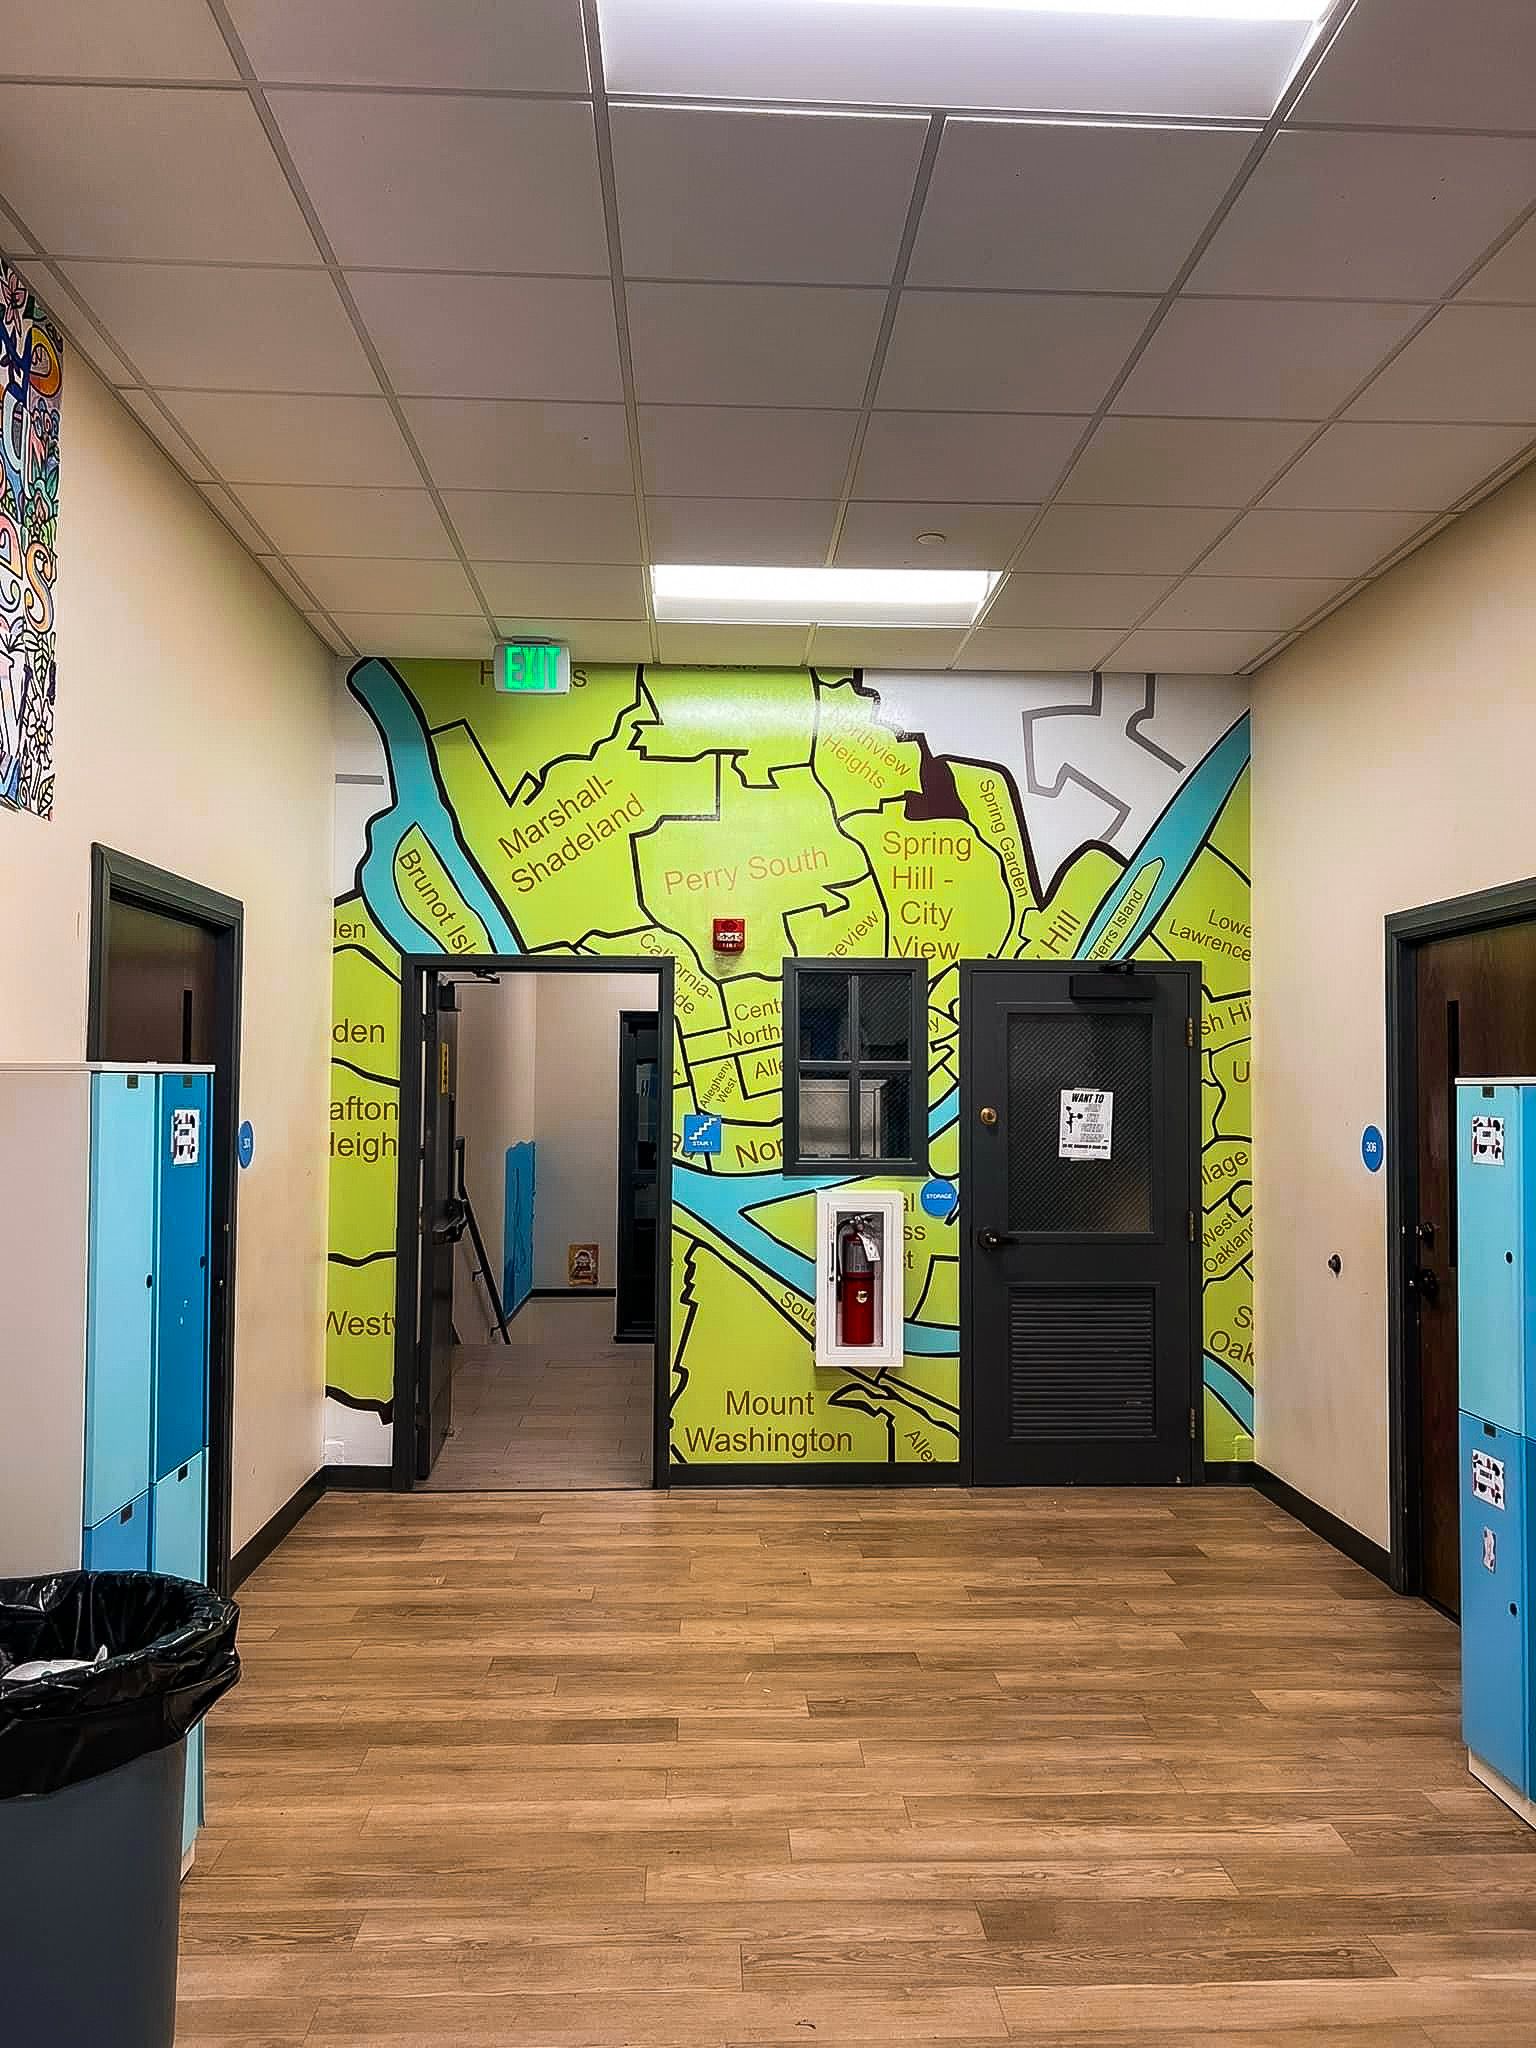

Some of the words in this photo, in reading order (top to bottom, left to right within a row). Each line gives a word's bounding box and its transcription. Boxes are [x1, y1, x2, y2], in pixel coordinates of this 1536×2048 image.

[505, 647, 561, 690] EXIT
[823, 735, 886, 789] Heights
[498, 775, 614, 859] Marshall-
[511, 793, 645, 893] Shadeland
[882, 831, 972, 861] Spring
[980, 779, 1005, 833] Spring
[1000, 837, 1029, 898] Garden
[664, 863, 738, 894] Perry
[748, 846, 828, 880] South
[893, 866, 933, 890] Hill
[398, 849, 455, 927] Brunot
[900, 901, 953, 930] City
[1112, 889, 1144, 928] Island
[893, 935, 960, 958] View
[1040, 910, 1080, 954] Hill
[1169, 919, 1251, 961] Lawrence
[332, 1018, 385, 1042] den
[699, 1060, 733, 1108] Allegheny
[716, 1077, 738, 1103] West
[1071, 1093, 1093, 1103] WANT
[1094, 1094, 1104, 1103] TO
[330, 1096, 399, 1121] afton
[1366, 1142, 1377, 1152] 306
[1202, 1212, 1238, 1248] West
[726, 1390, 814, 1416] Mount
[685, 1427, 852, 1459] Washington
[904, 1430, 938, 1462] Alle
